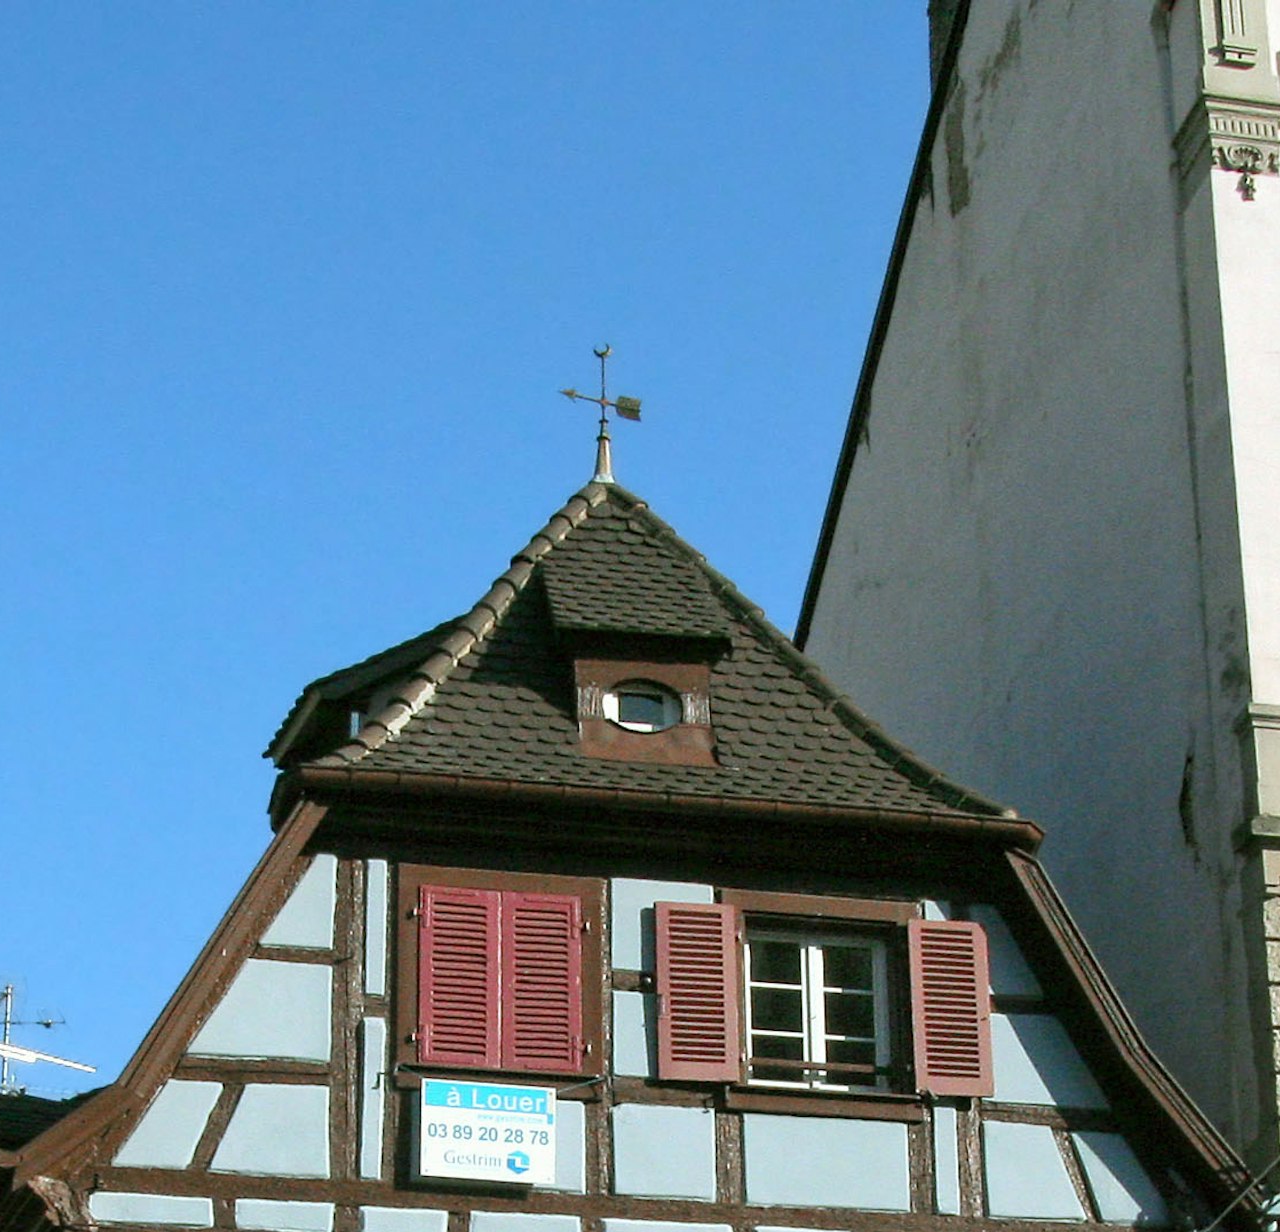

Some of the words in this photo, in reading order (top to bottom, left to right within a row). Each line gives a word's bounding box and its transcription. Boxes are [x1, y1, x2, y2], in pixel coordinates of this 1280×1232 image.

[447, 1086, 460, 1106] à
[472, 1088, 544, 1112] Louer
[428, 1123, 448, 1138] 03
[452, 1125, 473, 1140] 89
[478, 1127, 498, 1142] 20
[504, 1129, 524, 1144] 28
[529, 1130, 549, 1145] 78
[443, 1149, 501, 1167] Gestrim
